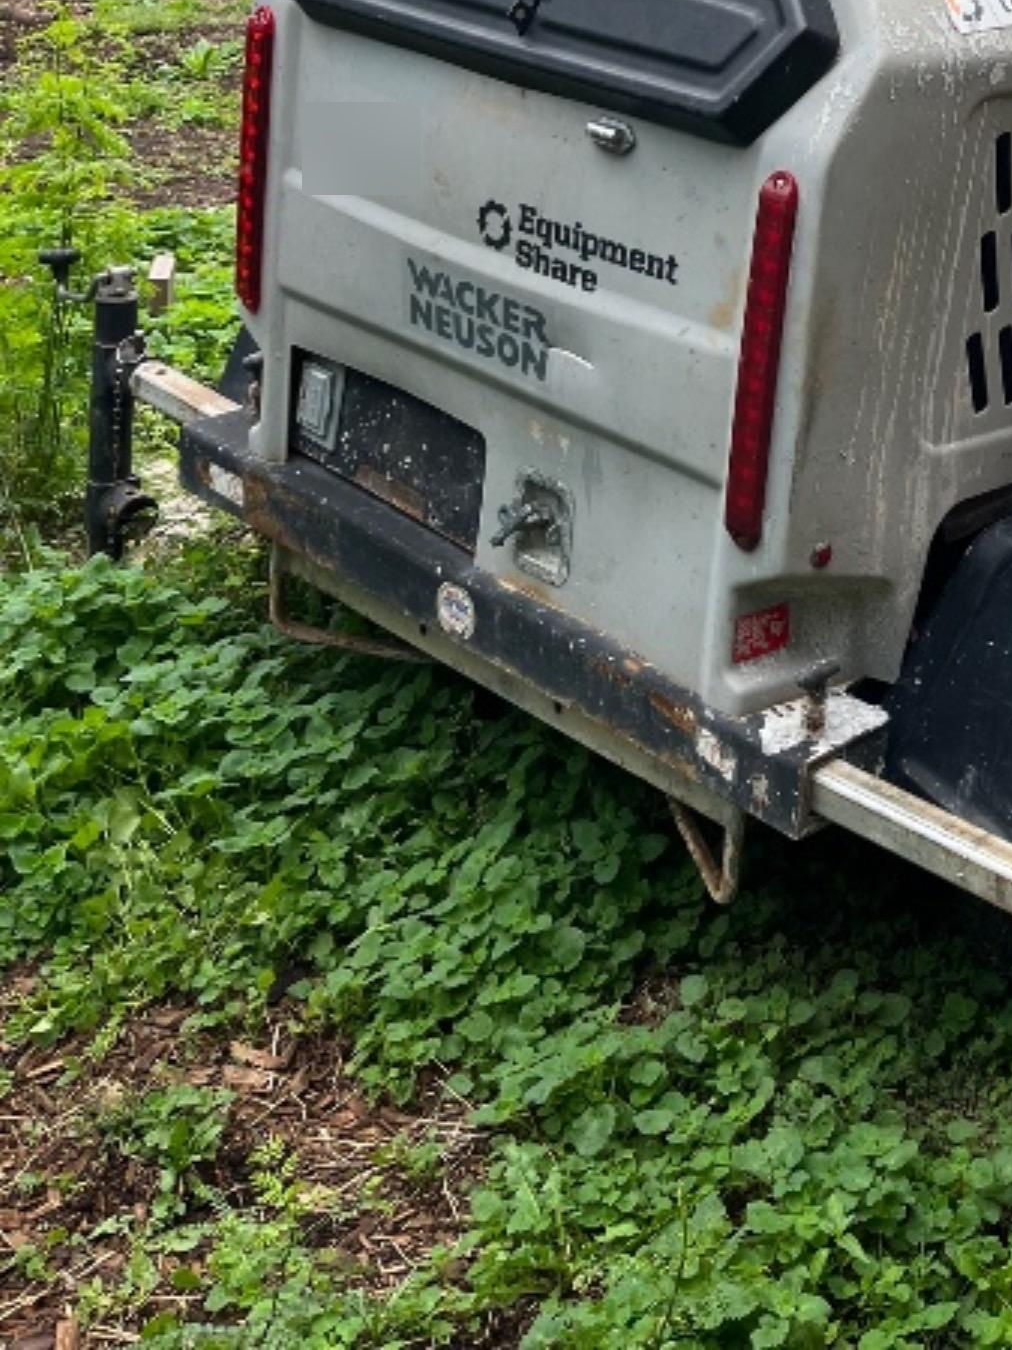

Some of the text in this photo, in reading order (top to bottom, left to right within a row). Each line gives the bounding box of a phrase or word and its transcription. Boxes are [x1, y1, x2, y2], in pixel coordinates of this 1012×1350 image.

[515, 239, 598, 292] Share
[518, 203, 679, 285] Equipment
[407, 257, 550, 346] WACKER
[409, 293, 548, 381] NEUSON
